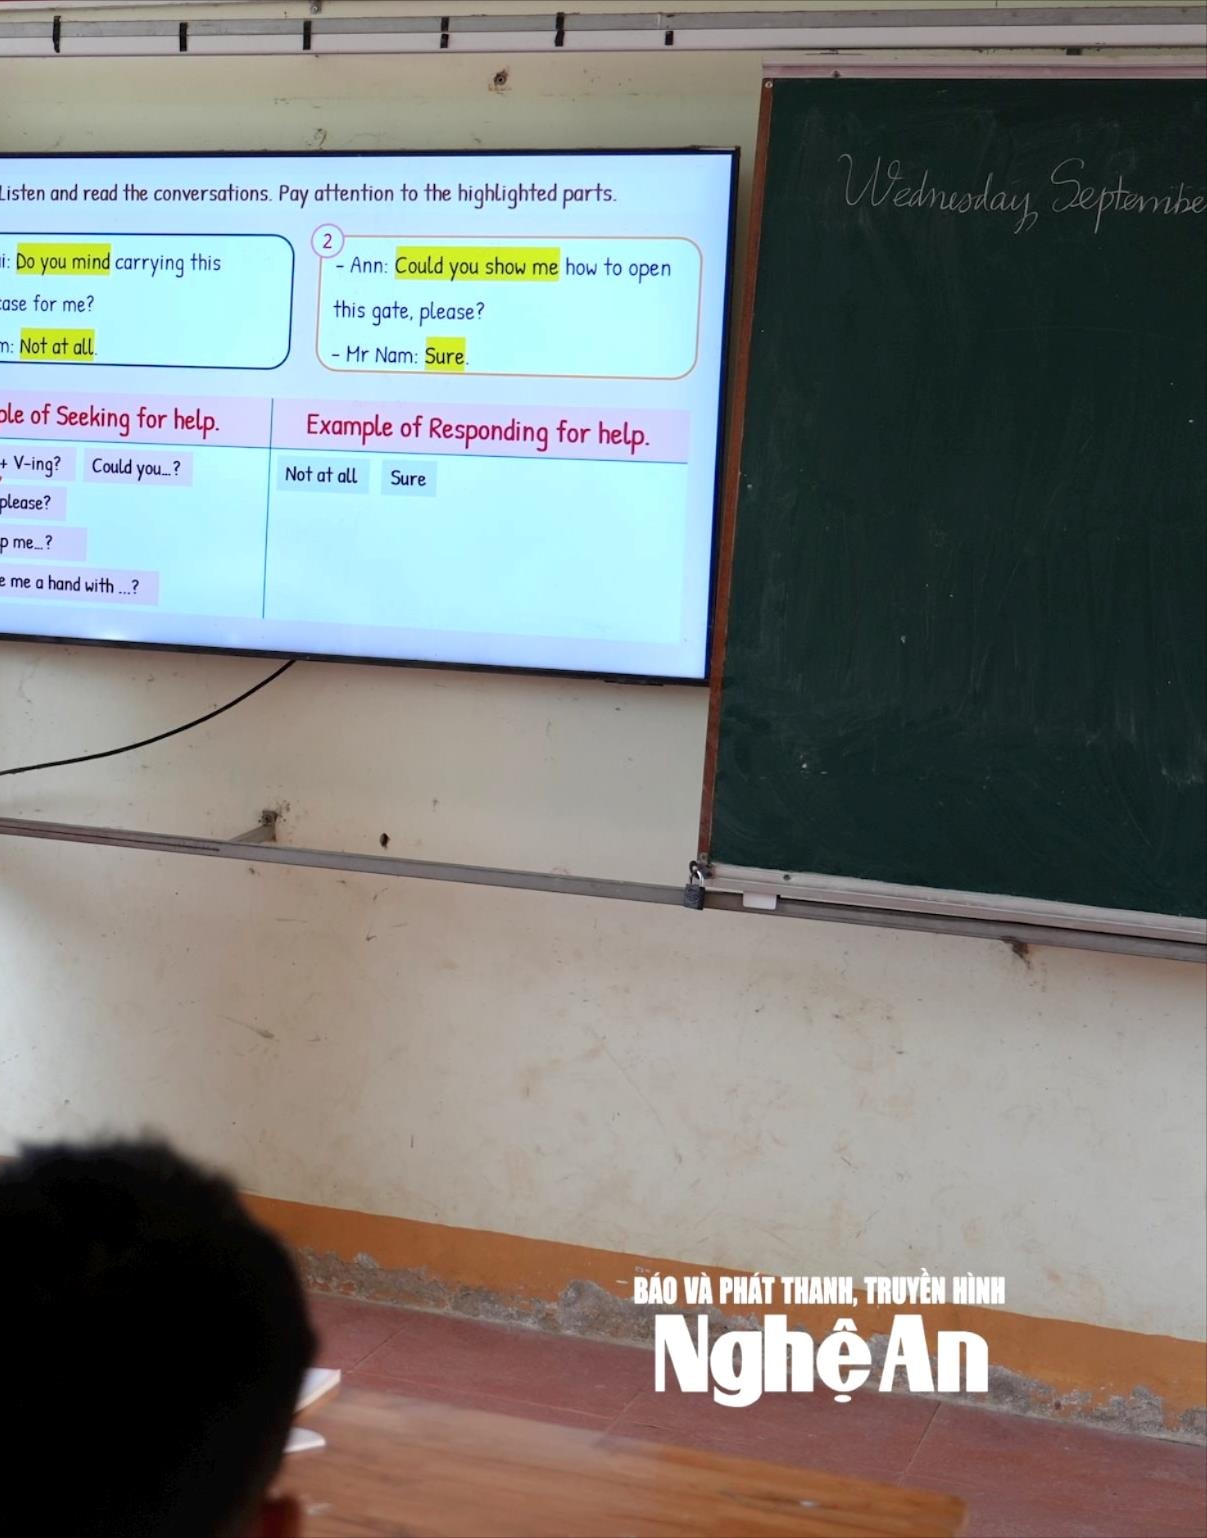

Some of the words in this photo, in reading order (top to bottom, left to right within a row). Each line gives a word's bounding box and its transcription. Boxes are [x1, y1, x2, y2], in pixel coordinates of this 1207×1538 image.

[51, 184, 77, 200] and
[83, 184, 117, 201] read
[123, 184, 148, 201] the
[154, 184, 272, 201] conversations.
[280, 185, 308, 208] Pay
[315, 184, 393, 201] attention
[400, 184, 418, 201] to
[424, 184, 451, 201] the
[459, 183, 557, 209] highlighted
[563, 183, 616, 209] parts.
[837, 153, 1038, 235] Wednesday,
[1050, 157, 1207, 235] Septembe
[323, 233, 332, 248] 2
[17, 253, 35, 270] Do
[41, 257, 66, 275] you
[73, 252, 110, 269] mind
[115, 258, 184, 278] carrying
[190, 253, 220, 270] this
[351, 257, 388, 273] Ann:
[395, 256, 443, 274] Could
[449, 262, 478, 281] you
[486, 257, 525, 275] show
[533, 263, 558, 275] me
[566, 257, 597, 275] how
[604, 258, 622, 276] to
[629, 264, 670, 283] open
[33, 294, 57, 311] for
[63, 295, 94, 312] me?
[333, 300, 365, 318] this
[372, 301, 413, 326] gate,
[420, 301, 484, 327] please?
[20, 337, 47, 354] Not
[53, 338, 68, 354] at
[74, 338, 97, 355] all.
[347, 346, 369, 362] Mr
[376, 347, 417, 363] Nam:
[425, 347, 469, 365] Sure.
[31, 403, 51, 424] of
[57, 405, 129, 437] Seeking
[137, 407, 167, 428] for
[175, 408, 219, 439] help.
[307, 414, 393, 445] Example
[401, 415, 423, 437] of
[430, 418, 548, 452] Responding
[556, 420, 591, 443] for
[599, 421, 649, 455] help.
[0, 459, 7, 468] +
[14, 455, 61, 478] V-ing?
[92, 458, 132, 474] Could
[286, 466, 312, 481] Not
[317, 467, 333, 482] at
[338, 468, 357, 483] all
[391, 470, 426, 486] Sure
[0, 494, 51, 514] please?
[11, 578, 31, 588] me
[36, 579, 43, 589] a
[49, 571, 80, 591] hand
[85, 578, 114, 593] with
